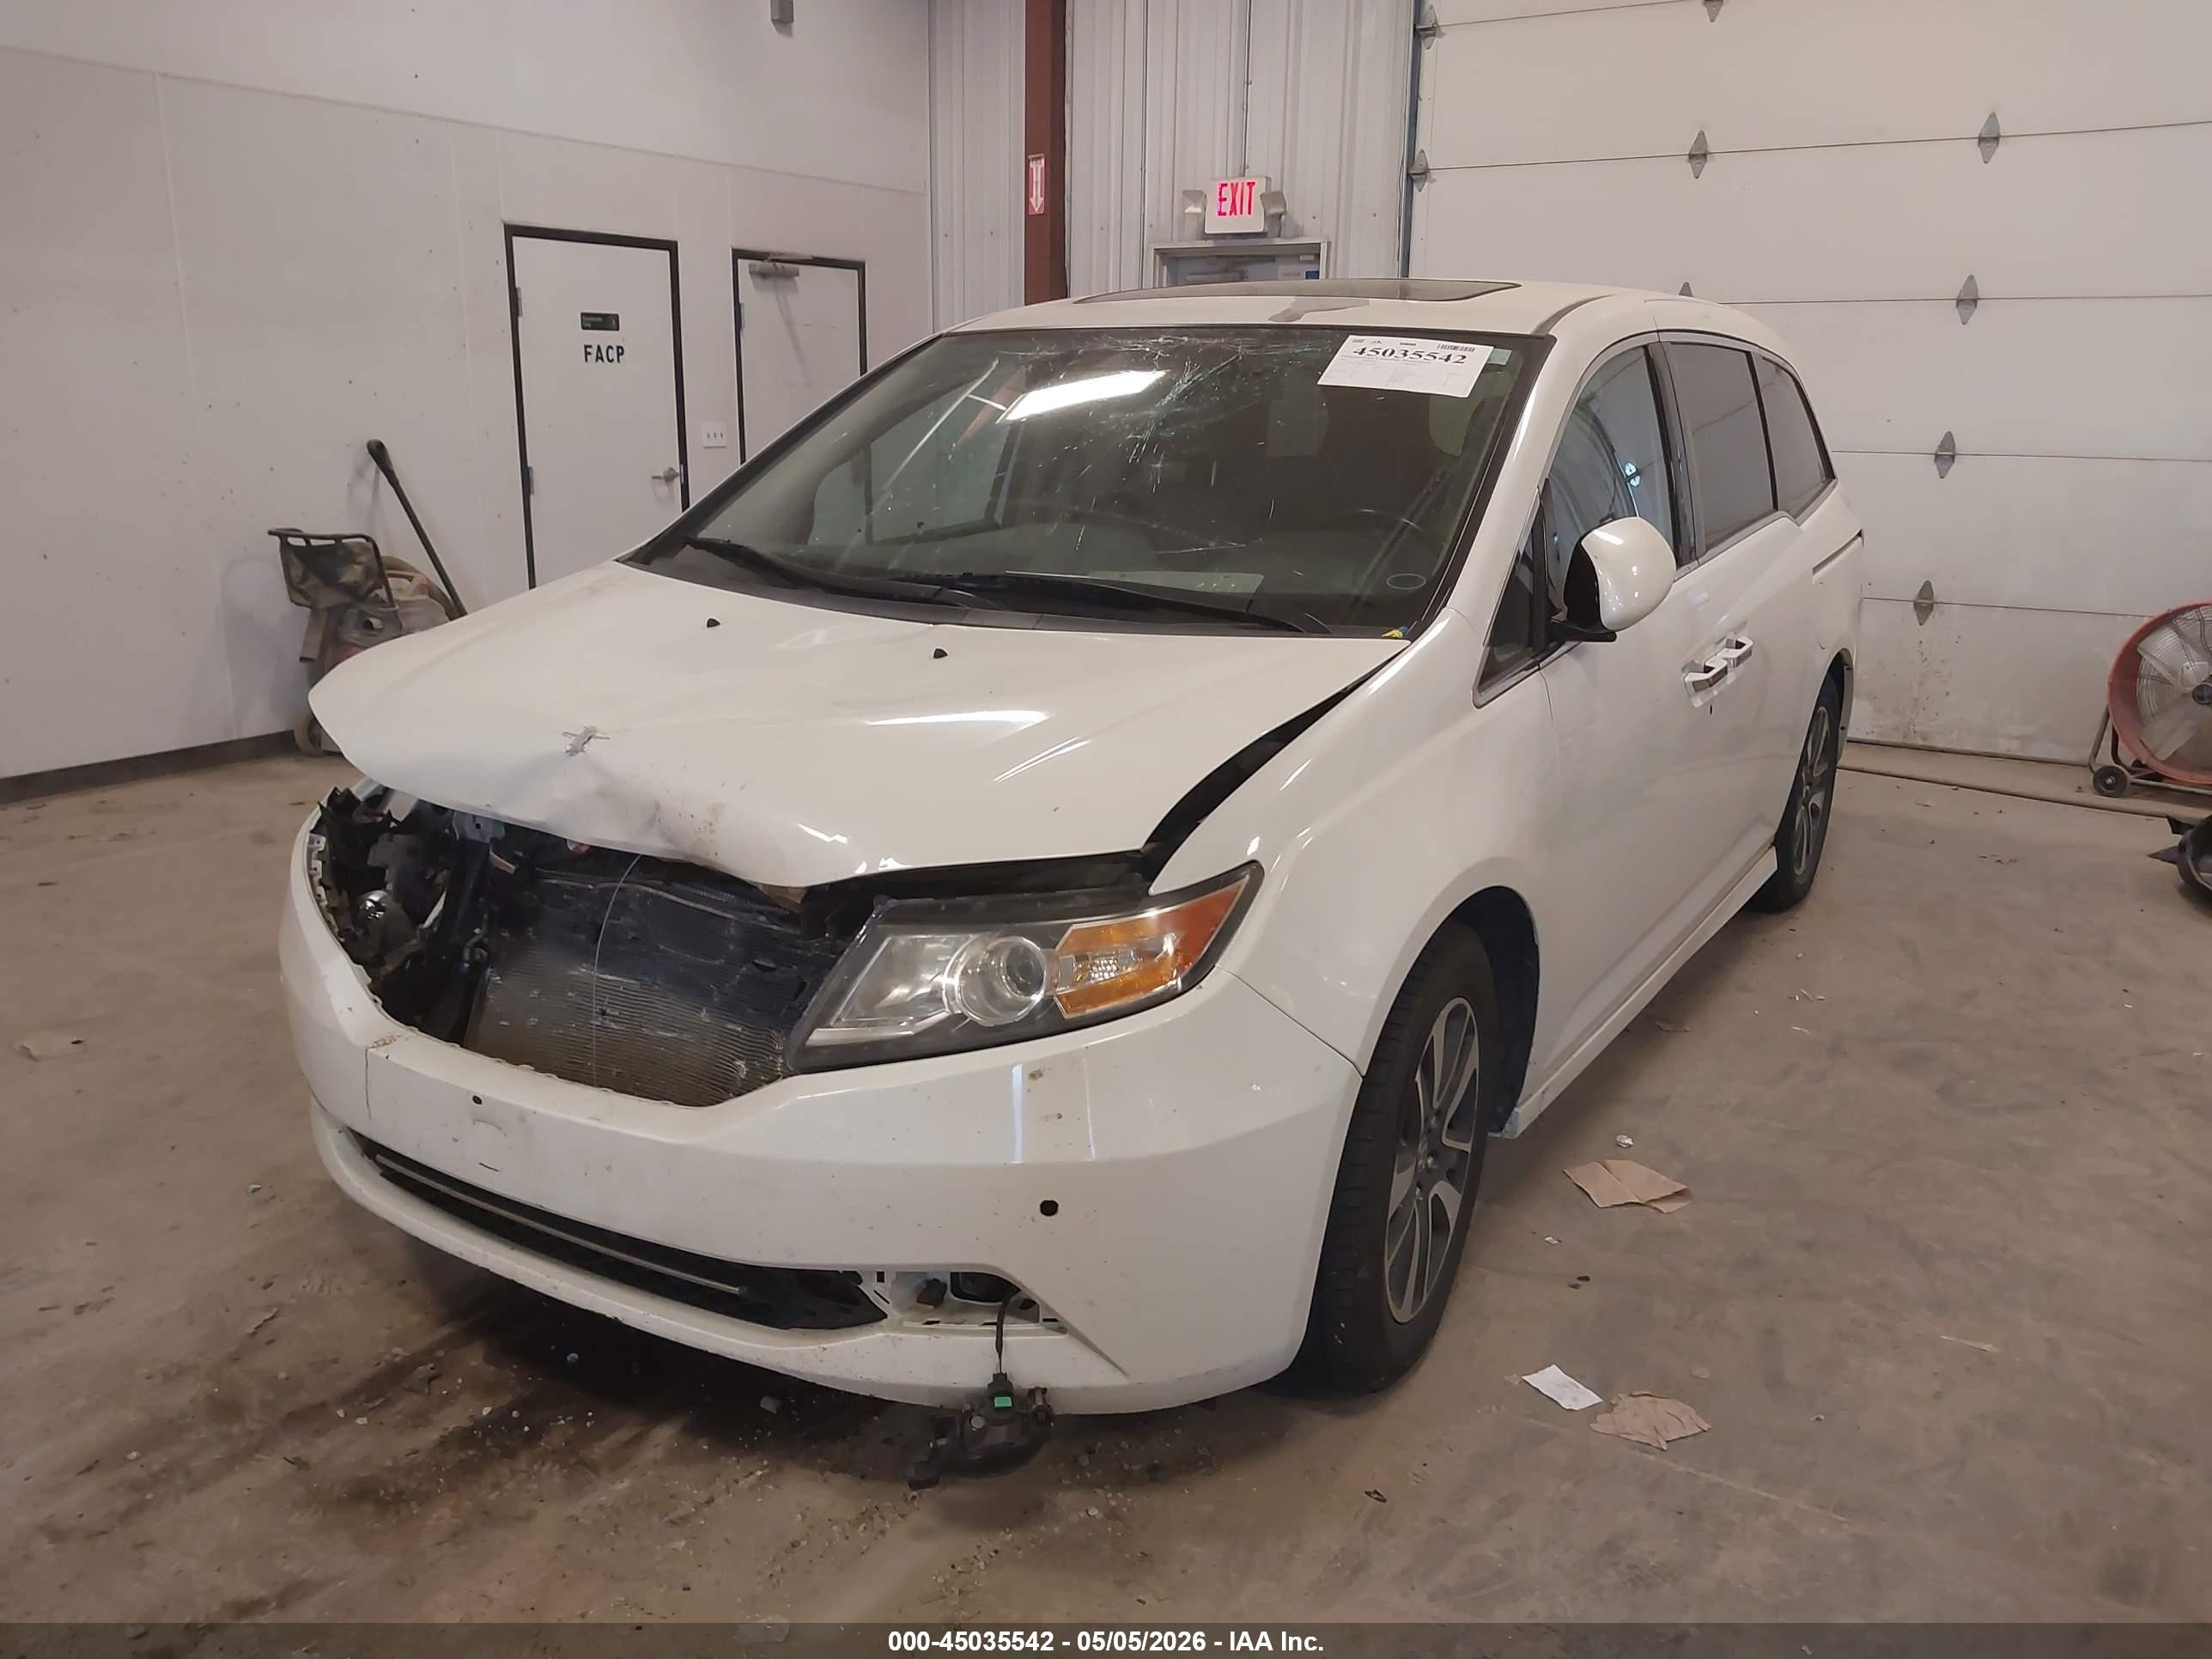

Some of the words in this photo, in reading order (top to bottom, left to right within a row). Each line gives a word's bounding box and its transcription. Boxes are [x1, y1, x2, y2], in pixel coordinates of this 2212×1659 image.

[1217, 181, 1255, 216] EXIT
[584, 344, 624, 363] FACP
[1352, 346, 1468, 364] 45035542
